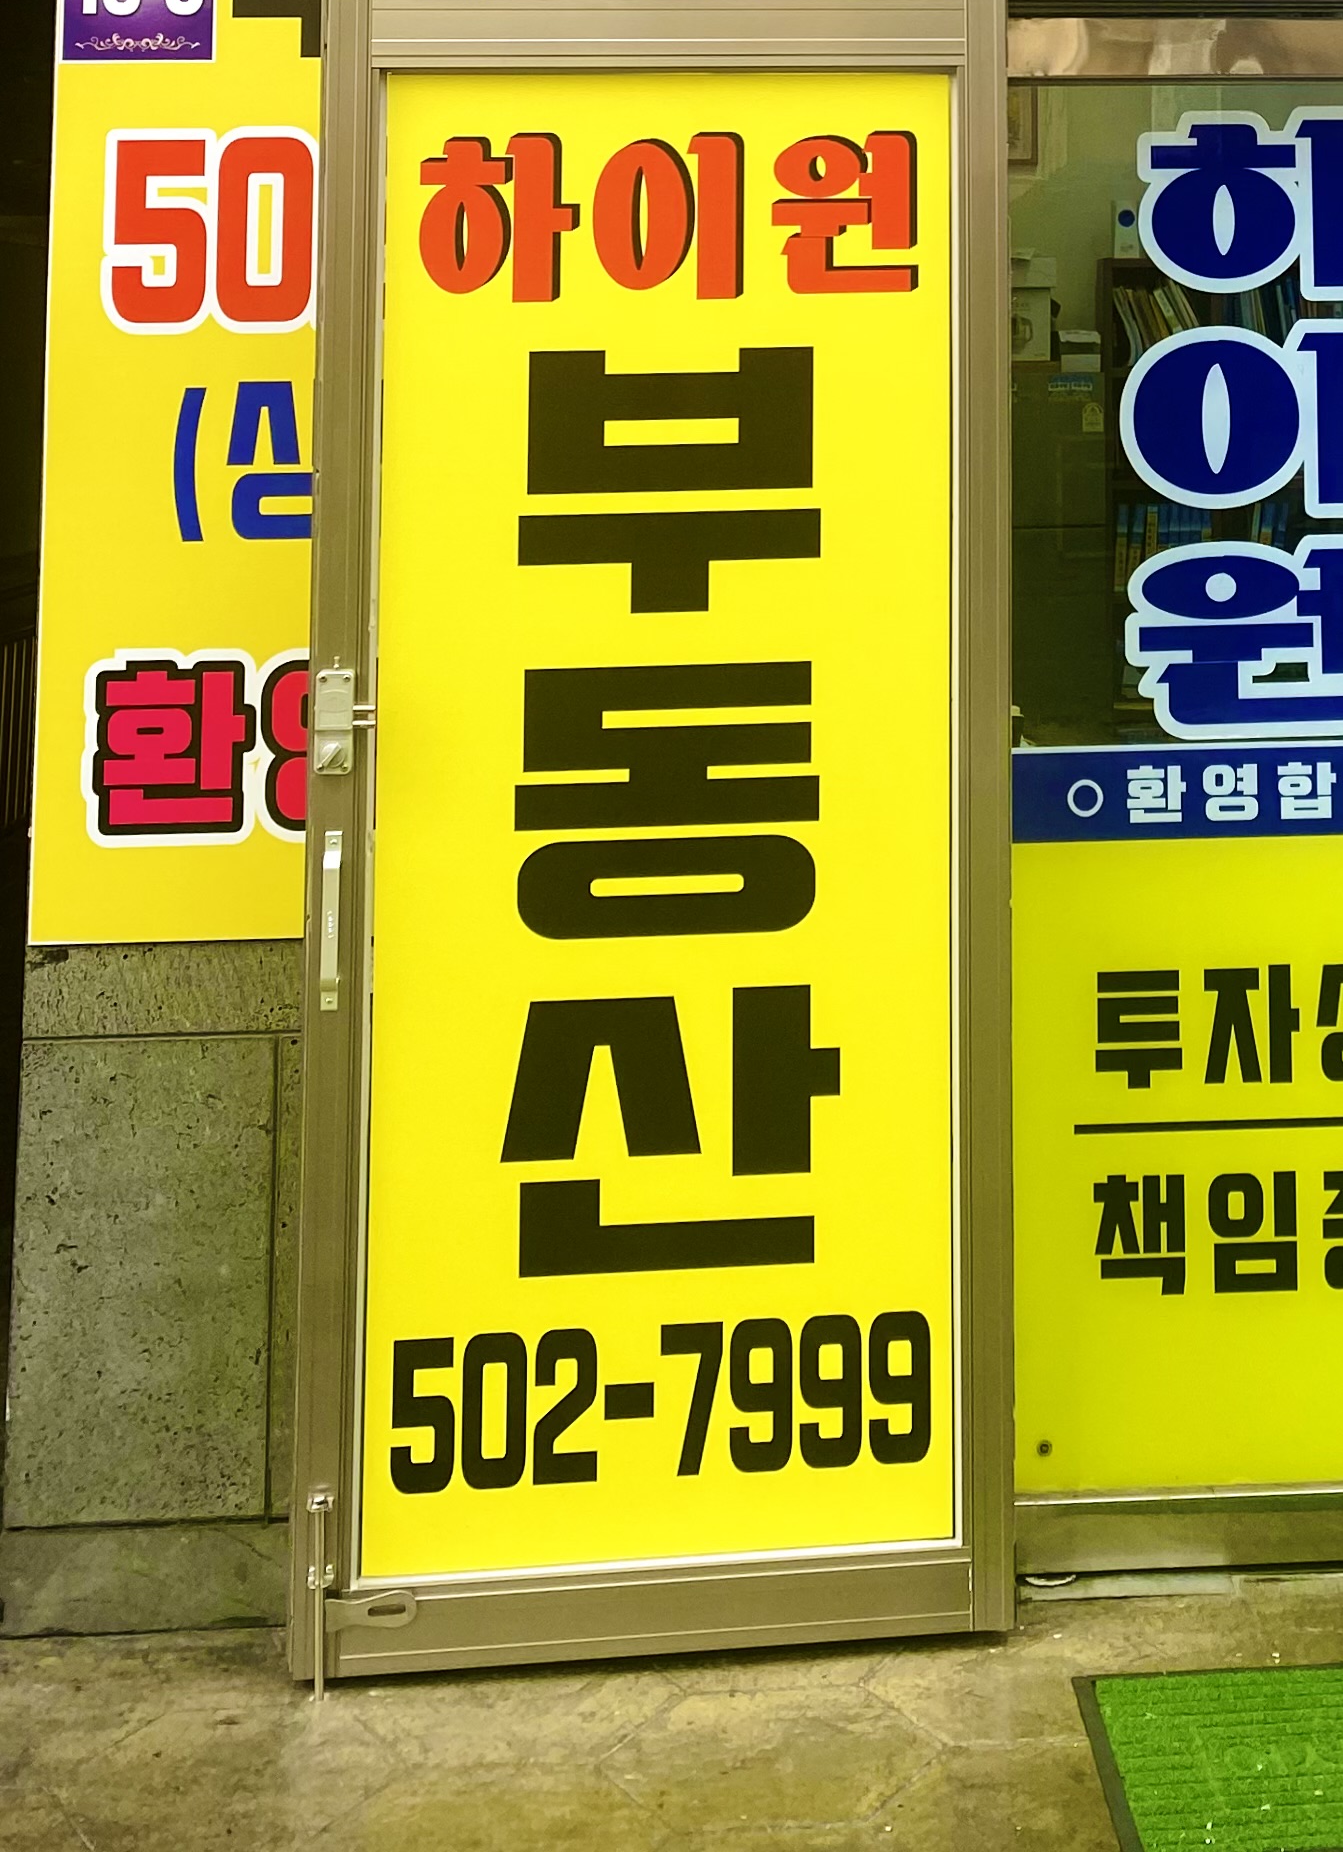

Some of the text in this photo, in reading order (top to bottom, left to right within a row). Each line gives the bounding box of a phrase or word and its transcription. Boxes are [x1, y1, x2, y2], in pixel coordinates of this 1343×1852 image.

[418, 130, 920, 302] 하이원
[499, 346, 842, 1280] 부동산
[391, 1310, 932, 1494] 502-7999
